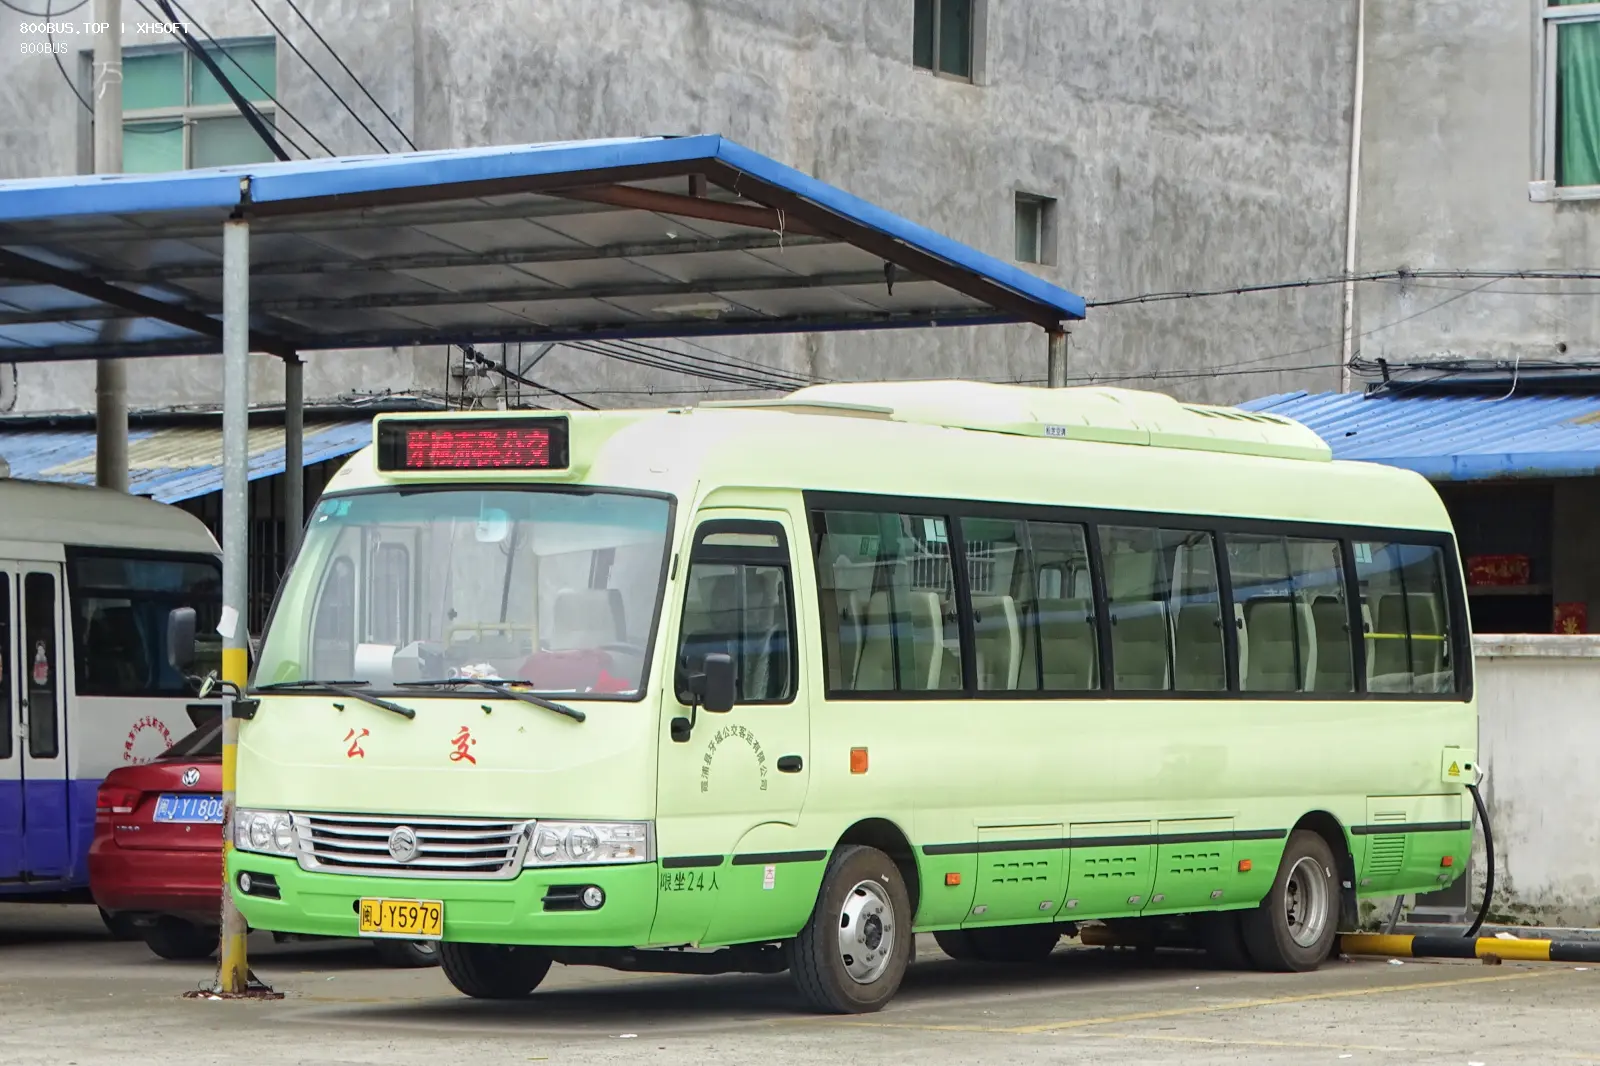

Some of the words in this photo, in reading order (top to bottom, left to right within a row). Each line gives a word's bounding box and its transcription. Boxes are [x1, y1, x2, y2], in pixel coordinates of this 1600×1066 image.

[343, 727, 370, 759] 公
[449, 725, 477, 765] 交
[660, 871, 719, 891] 限坐24人
